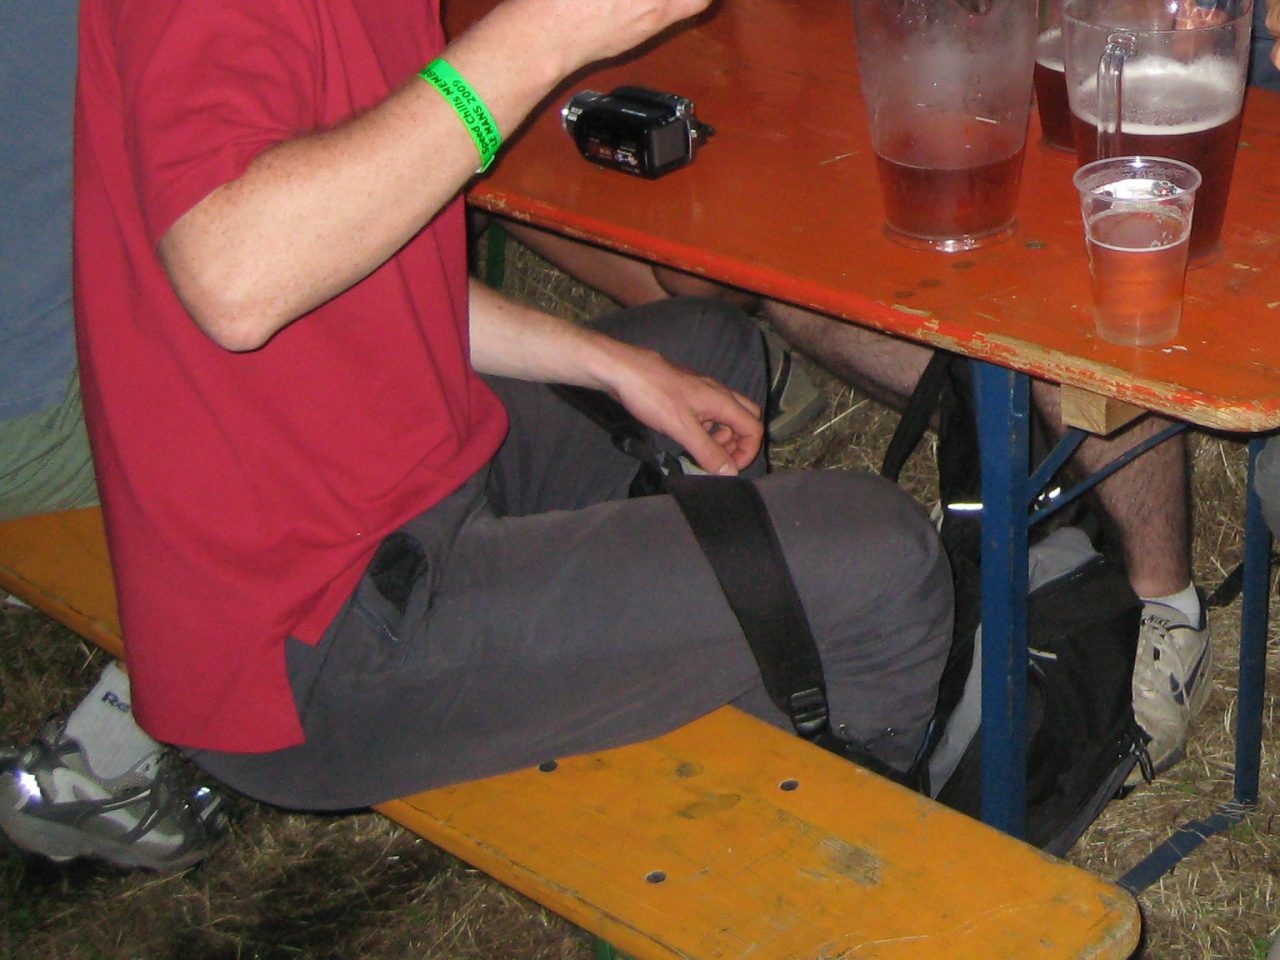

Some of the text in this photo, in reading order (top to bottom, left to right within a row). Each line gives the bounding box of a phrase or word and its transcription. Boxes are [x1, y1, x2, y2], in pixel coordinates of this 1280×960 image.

[452, 79, 498, 148] LE MANS 2009
[453, 96, 478, 125] Chills
[470, 125, 490, 155] Speed
